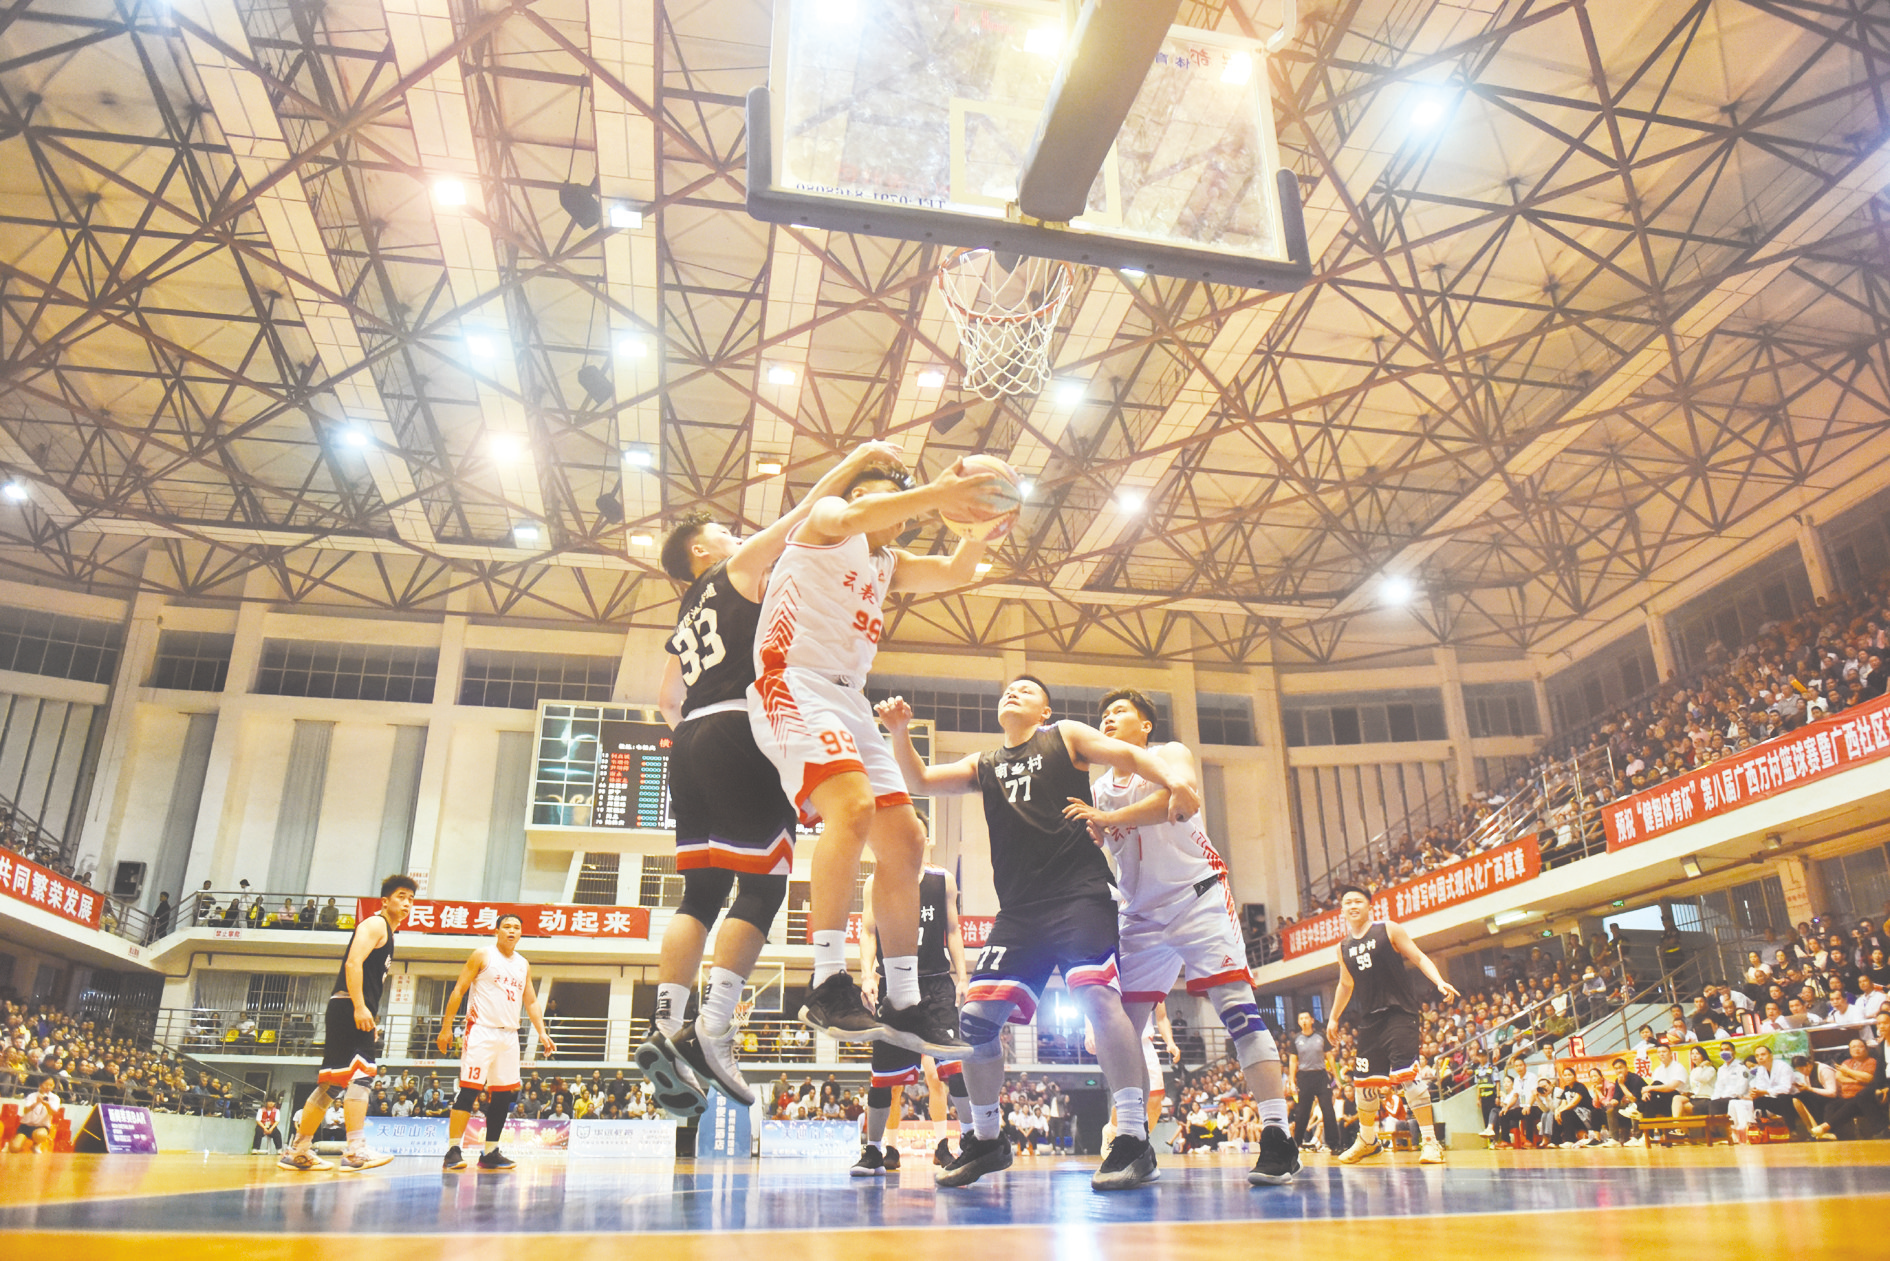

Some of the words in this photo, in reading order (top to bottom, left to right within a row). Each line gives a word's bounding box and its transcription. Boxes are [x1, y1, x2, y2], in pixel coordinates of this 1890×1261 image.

[843, 569, 885, 604] 云表
[853, 610, 882, 644] 99
[672, 608, 726, 686] 33
[819, 730, 857, 755] 99
[995, 754, 1043, 779] 南乡村
[1005, 775, 1031, 803] 77
[0, 855, 94, 922] 共同繁荣发展
[375, 905, 498, 930] 民健身
[539, 910, 631, 934] 动起来
[921, 905, 935, 922] 村
[976, 946, 1007, 971] 77
[1356, 953, 1373, 971] 59
[468, 1066, 481, 1080] 13
[1356, 1057, 1369, 1073] 59
